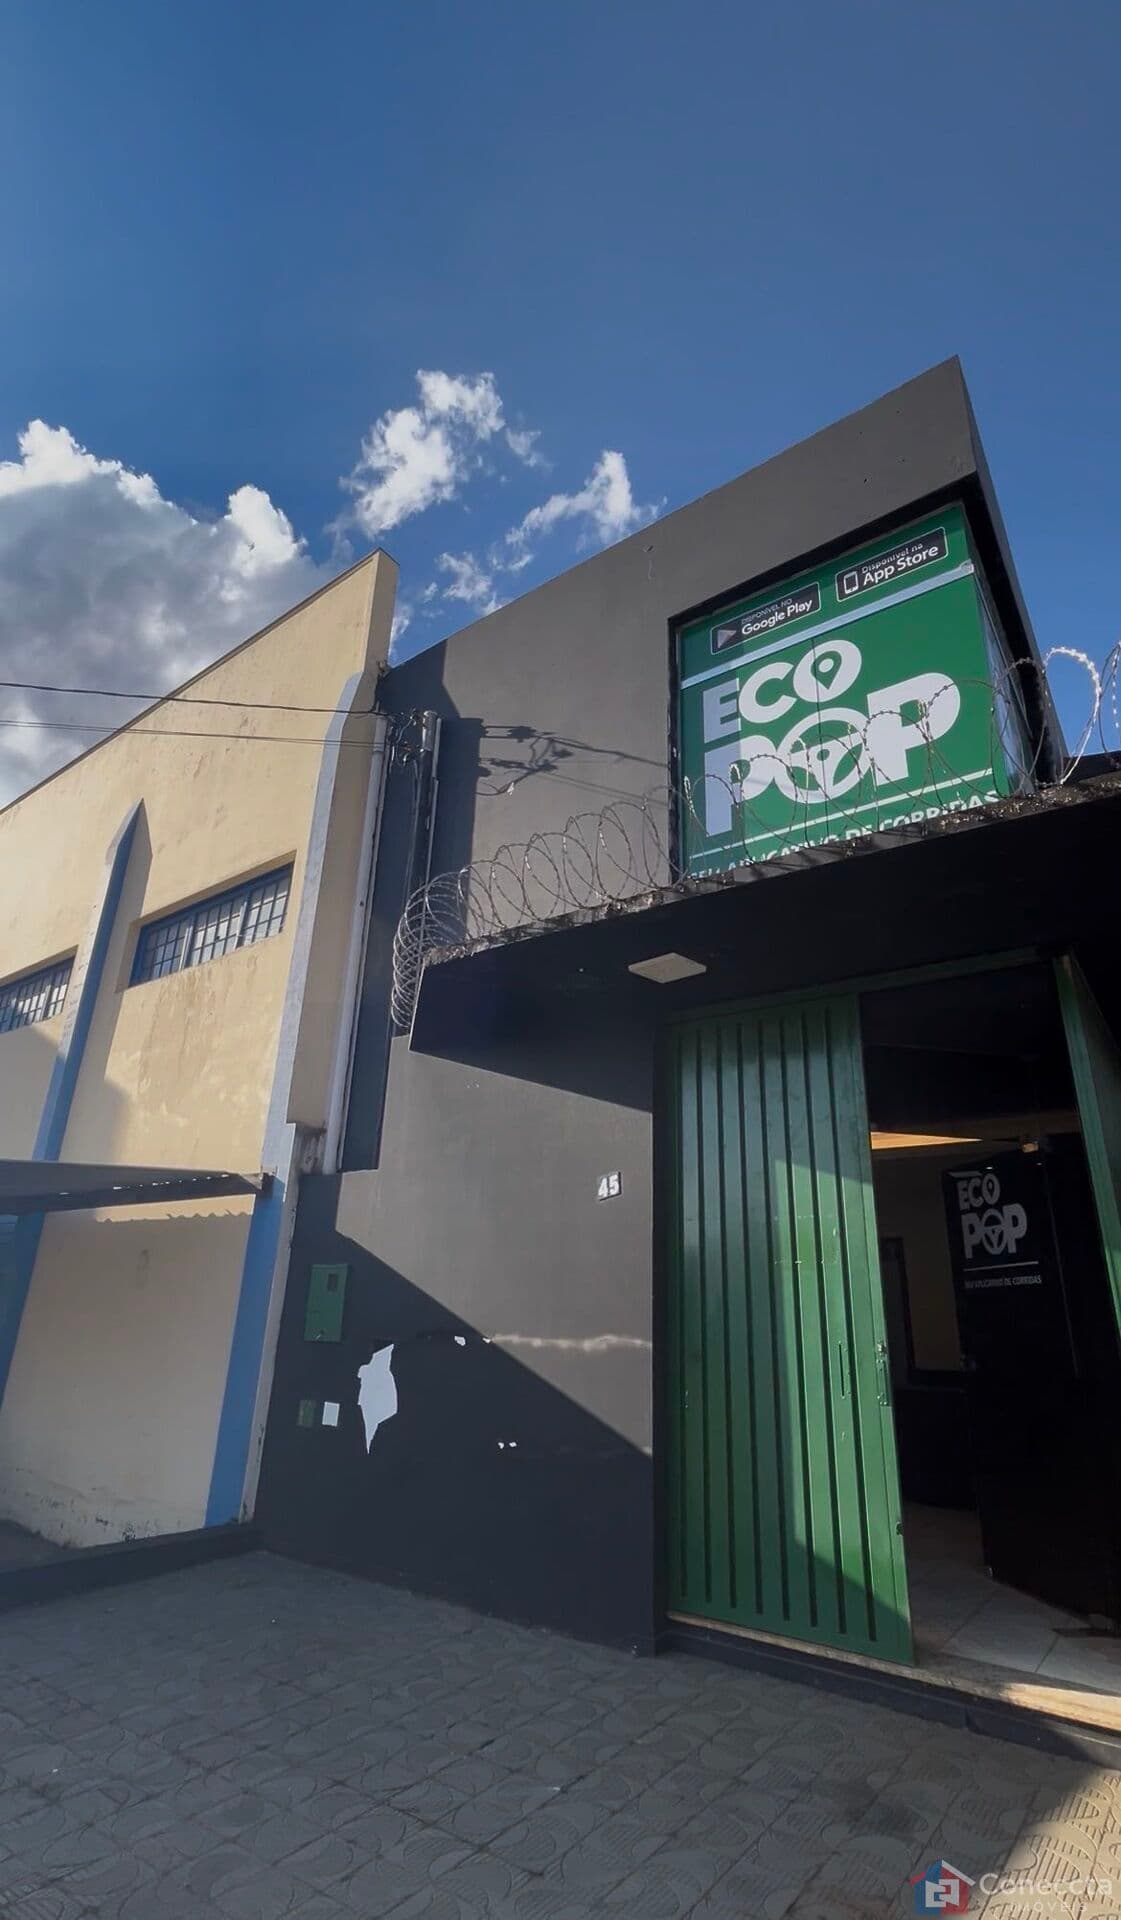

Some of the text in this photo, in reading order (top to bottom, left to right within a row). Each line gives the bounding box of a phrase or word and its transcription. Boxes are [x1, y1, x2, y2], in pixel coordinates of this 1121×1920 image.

[863, 546, 939, 586] App Store
[741, 600, 812, 635] Google Play
[781, 598, 793, 608] NO
[703, 639, 862, 743] ECO
[704, 672, 961, 838] POP
[598, 1174, 619, 1197] 45
[957, 1173, 1000, 1211] ECO
[961, 1203, 1027, 1259] POP
